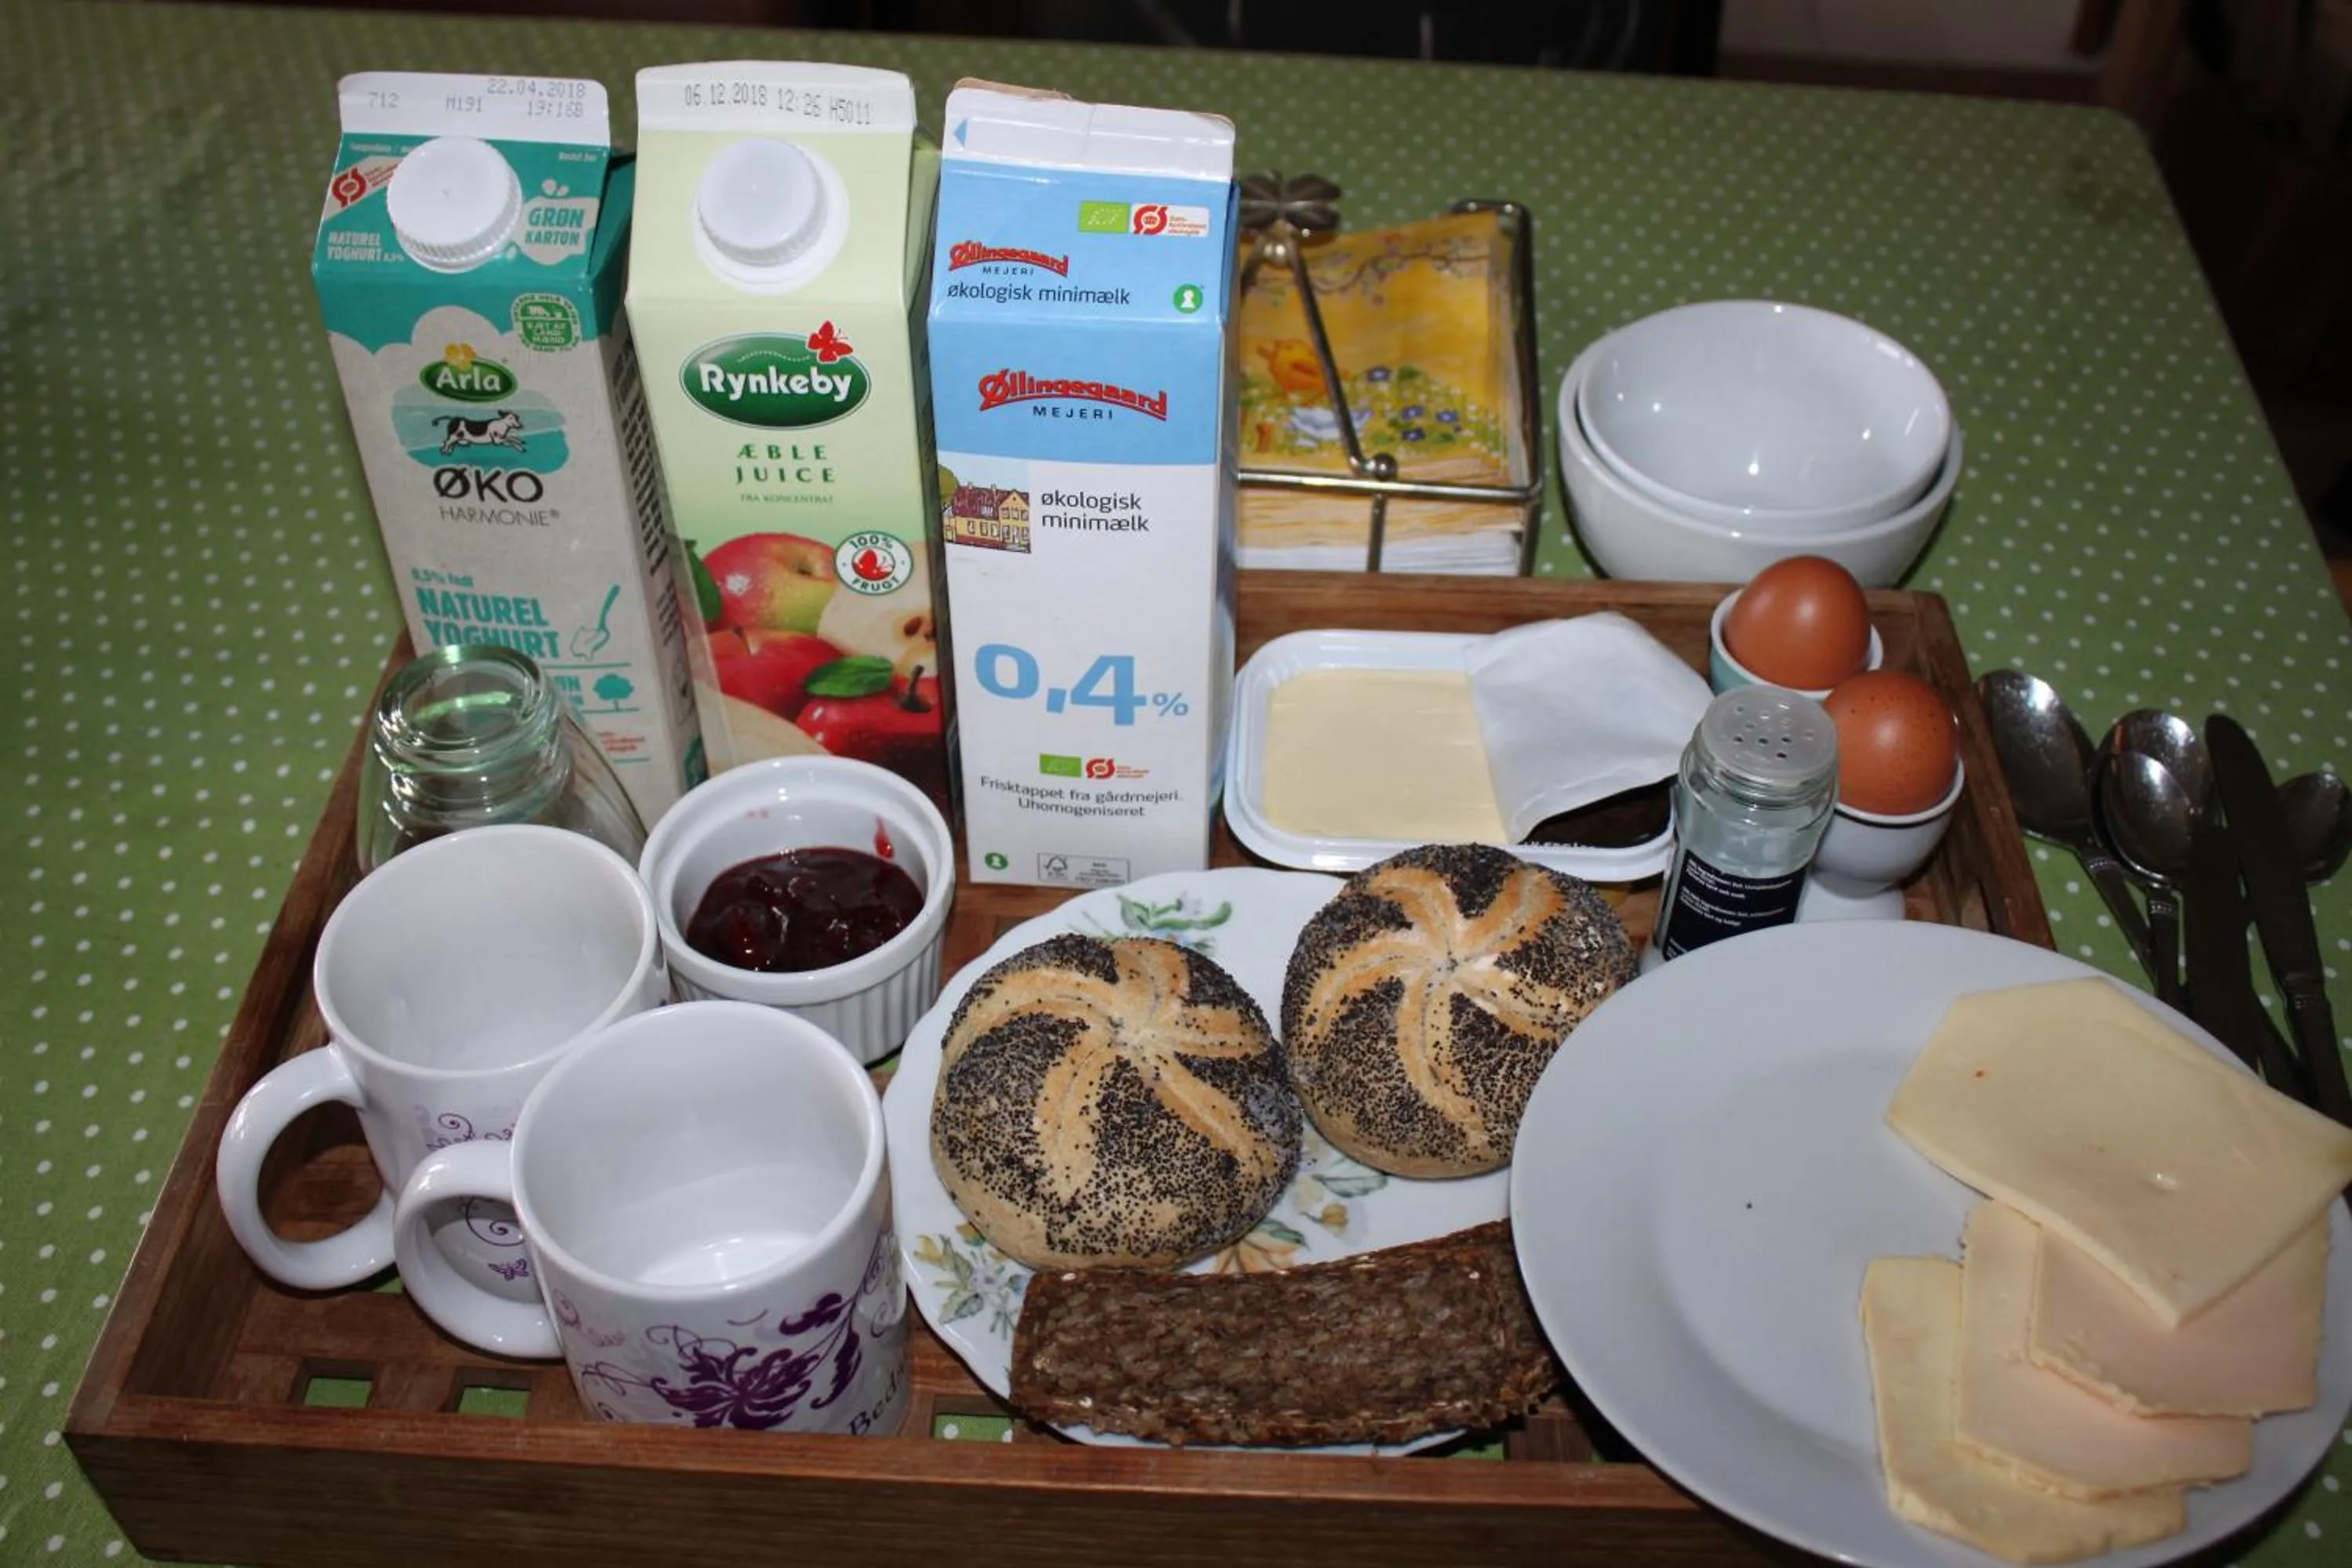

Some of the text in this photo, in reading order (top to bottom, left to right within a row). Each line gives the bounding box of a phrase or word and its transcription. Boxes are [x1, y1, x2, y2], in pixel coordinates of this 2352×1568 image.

[368, 91, 400, 108] 712
[525, 230, 579, 245] KARTON
[982, 267, 1034, 276] MEJERI
[946, 282, 1130, 305] økologisk minimælk
[436, 367, 502, 393] Arla
[699, 362, 853, 403] Rynkeby
[1033, 405, 1113, 419] MEJERI
[737, 444, 827, 460] ÆBLE
[433, 466, 544, 503] ØKO
[735, 466, 836, 485] JUICE
[1040, 489, 1142, 514] økologisk
[1041, 512, 1150, 532] minimælk
[415, 586, 550, 626] NATUREL
[424, 619, 561, 659] YOGHURT
[1070, 789, 1091, 801] fra
[1018, 797, 1145, 818] Uhomogeniseret
